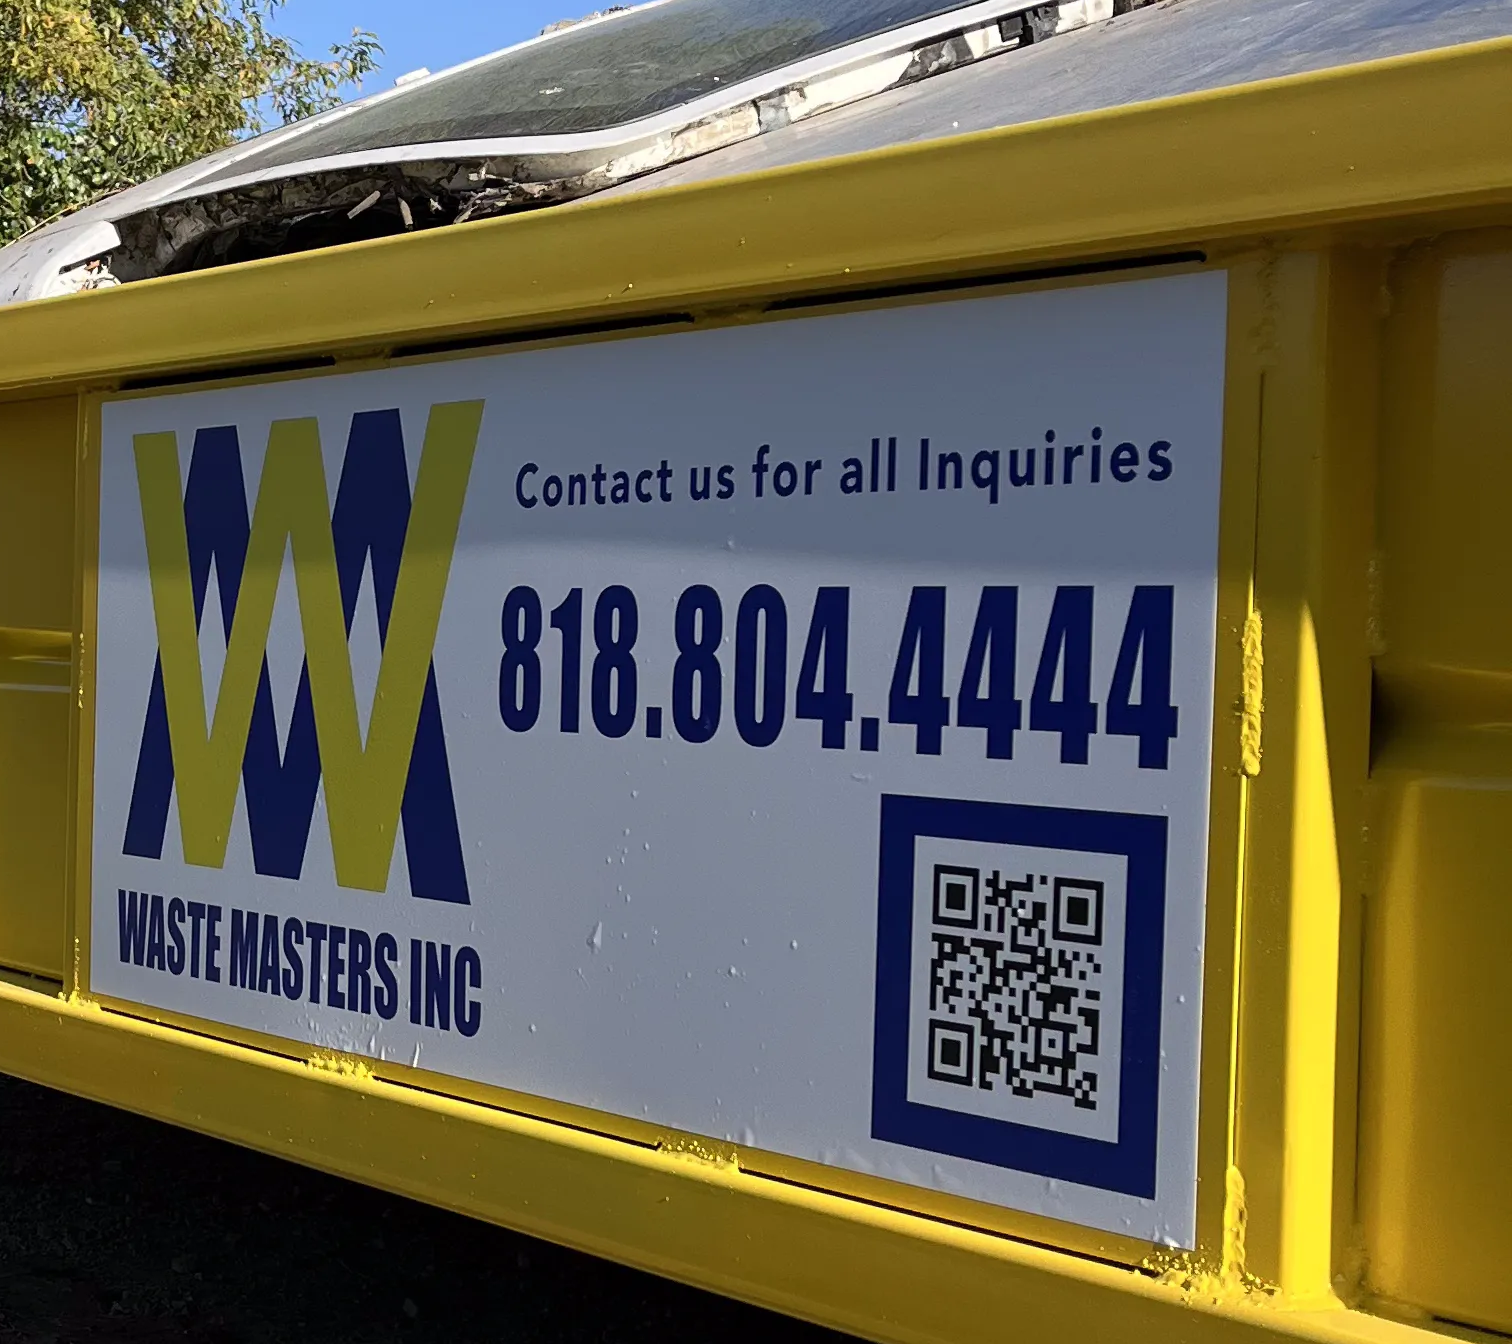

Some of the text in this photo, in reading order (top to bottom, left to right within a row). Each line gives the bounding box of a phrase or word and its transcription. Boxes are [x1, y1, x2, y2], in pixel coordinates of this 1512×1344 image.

[515, 426, 1173, 509] Contact us for all Inquiries
[498, 583, 1179, 771] 818.804.4444
[118, 888, 482, 1038] WASTE MASTERS INC
